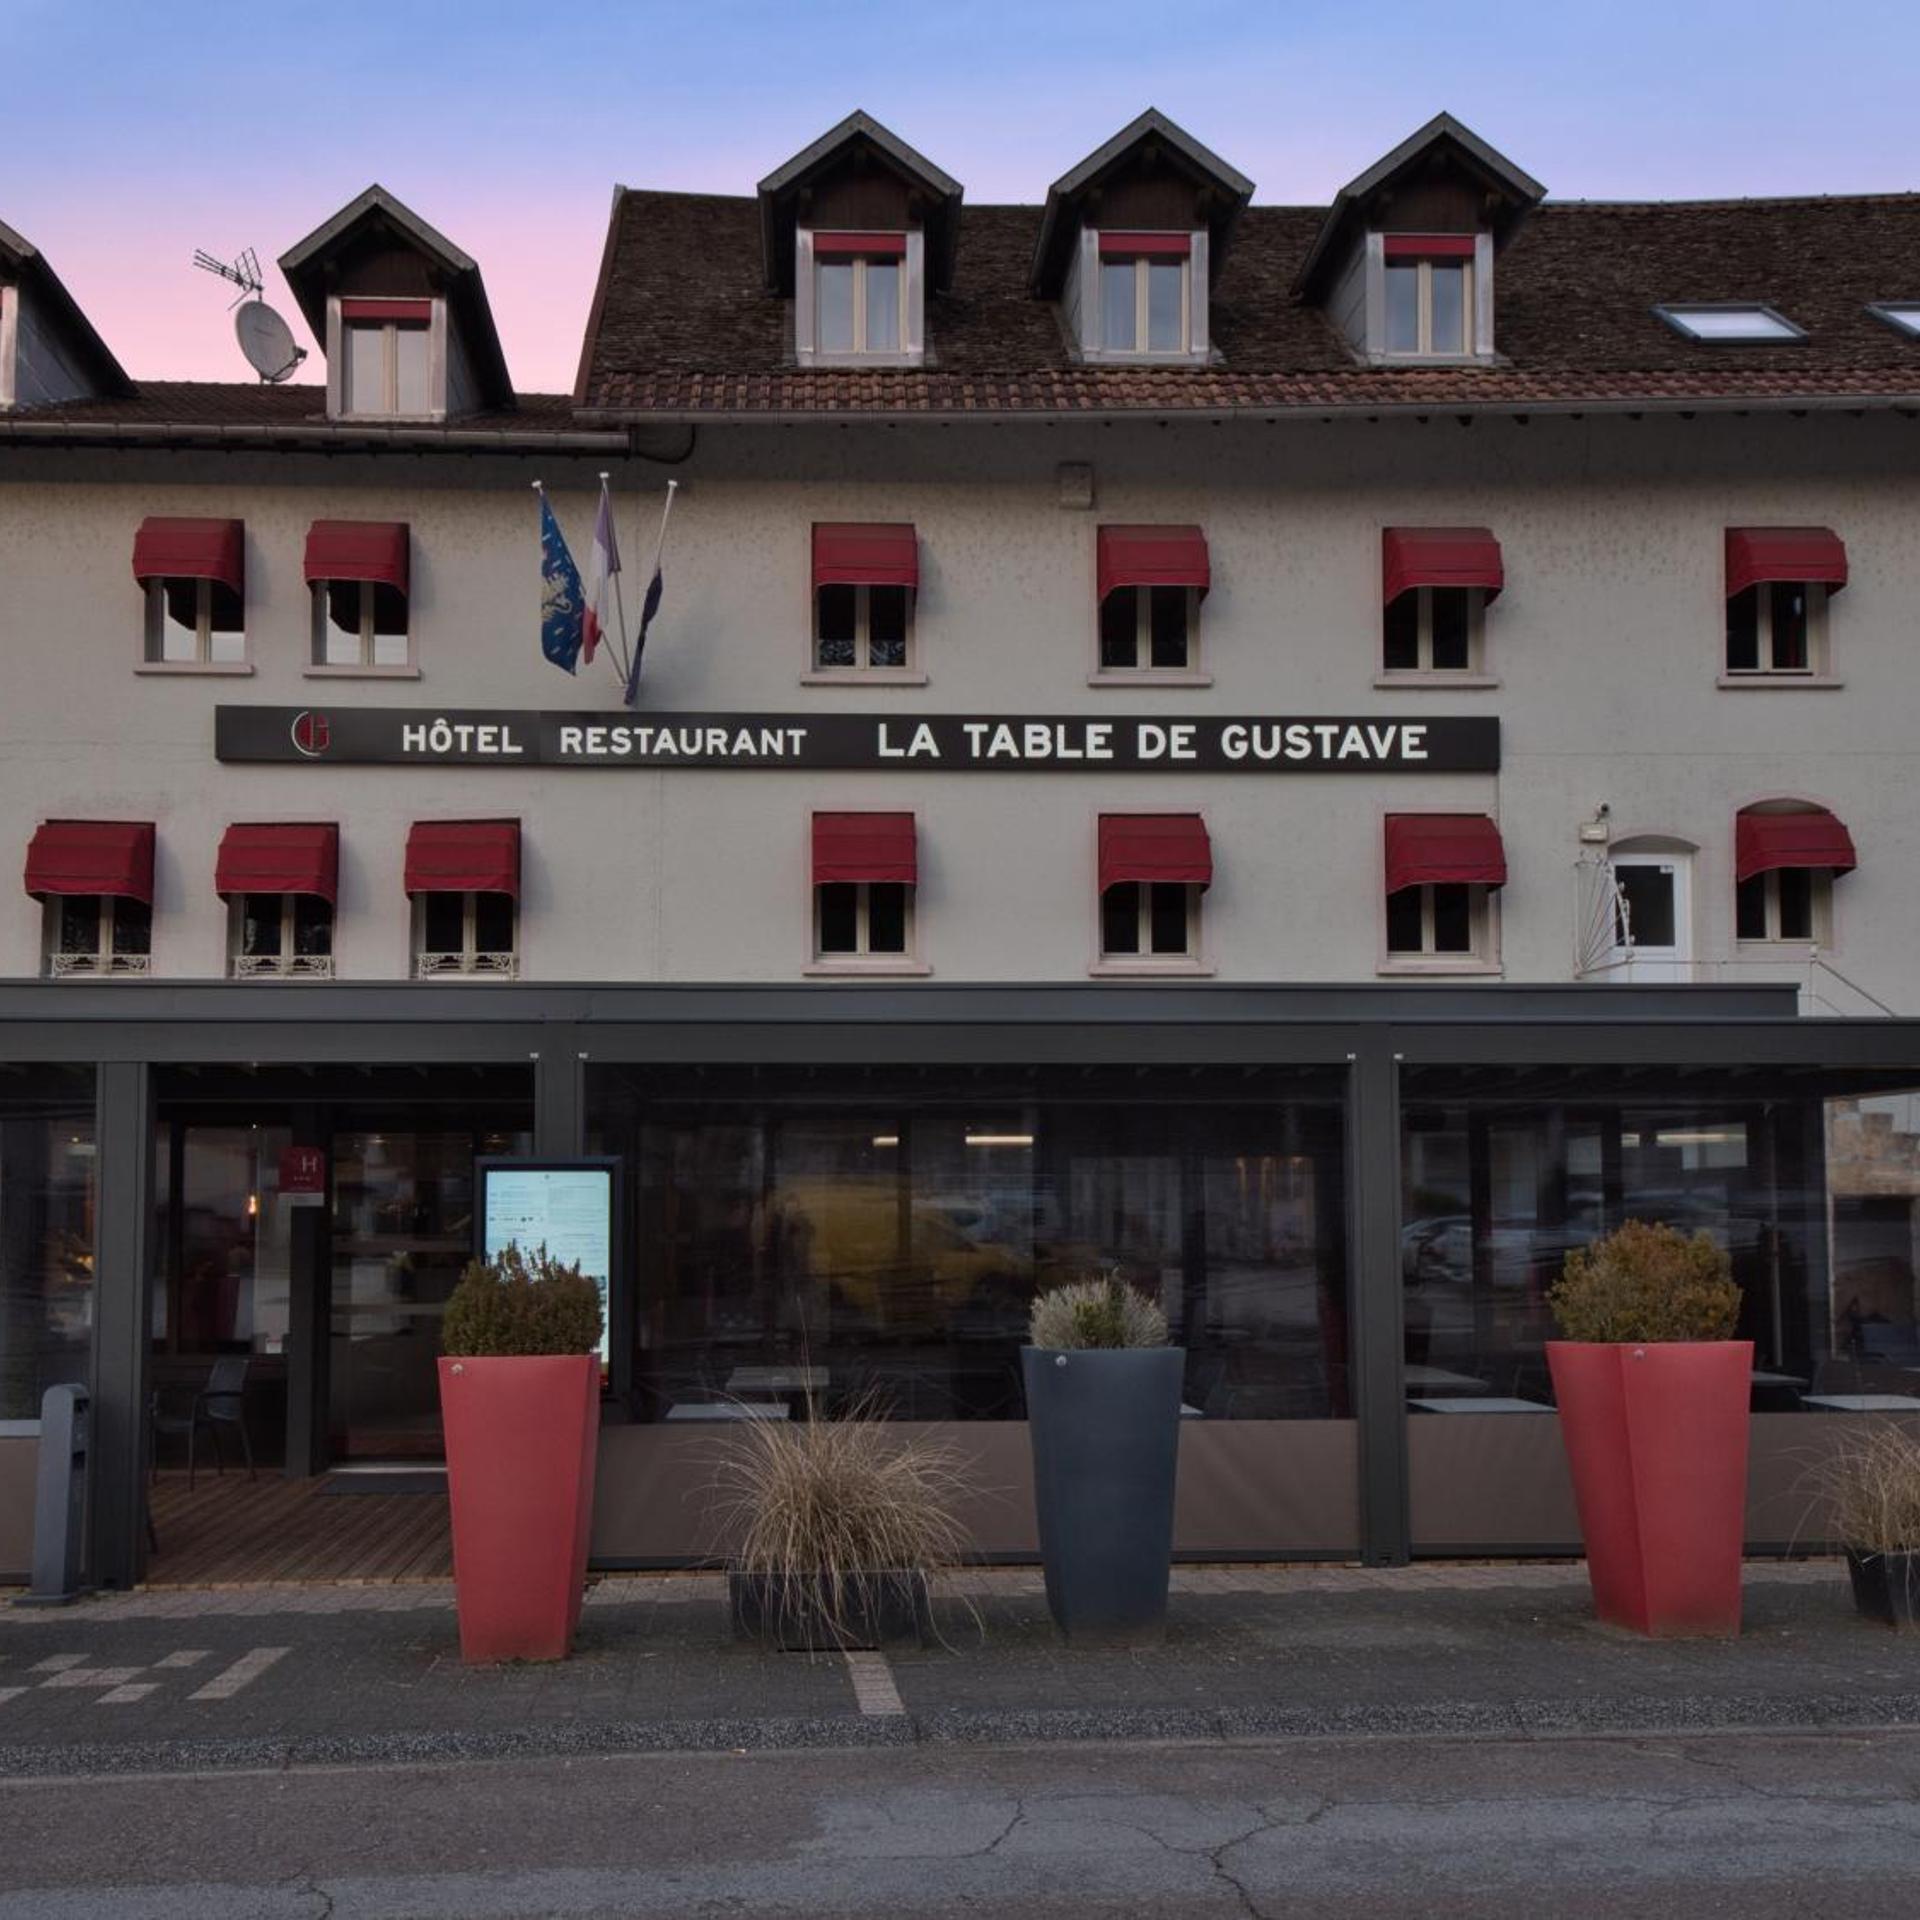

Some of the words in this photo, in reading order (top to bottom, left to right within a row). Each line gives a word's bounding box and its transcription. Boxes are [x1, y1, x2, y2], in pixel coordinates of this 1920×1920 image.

[402, 717, 524, 754] HÔTEL
[559, 726, 808, 756] RESTAURANT
[878, 722, 940, 758] LA
[963, 723, 1114, 759] TABLE
[1137, 723, 1197, 759] DE
[1220, 724, 1429, 760] GUSTAVE
[301, 1155, 317, 1173] H
